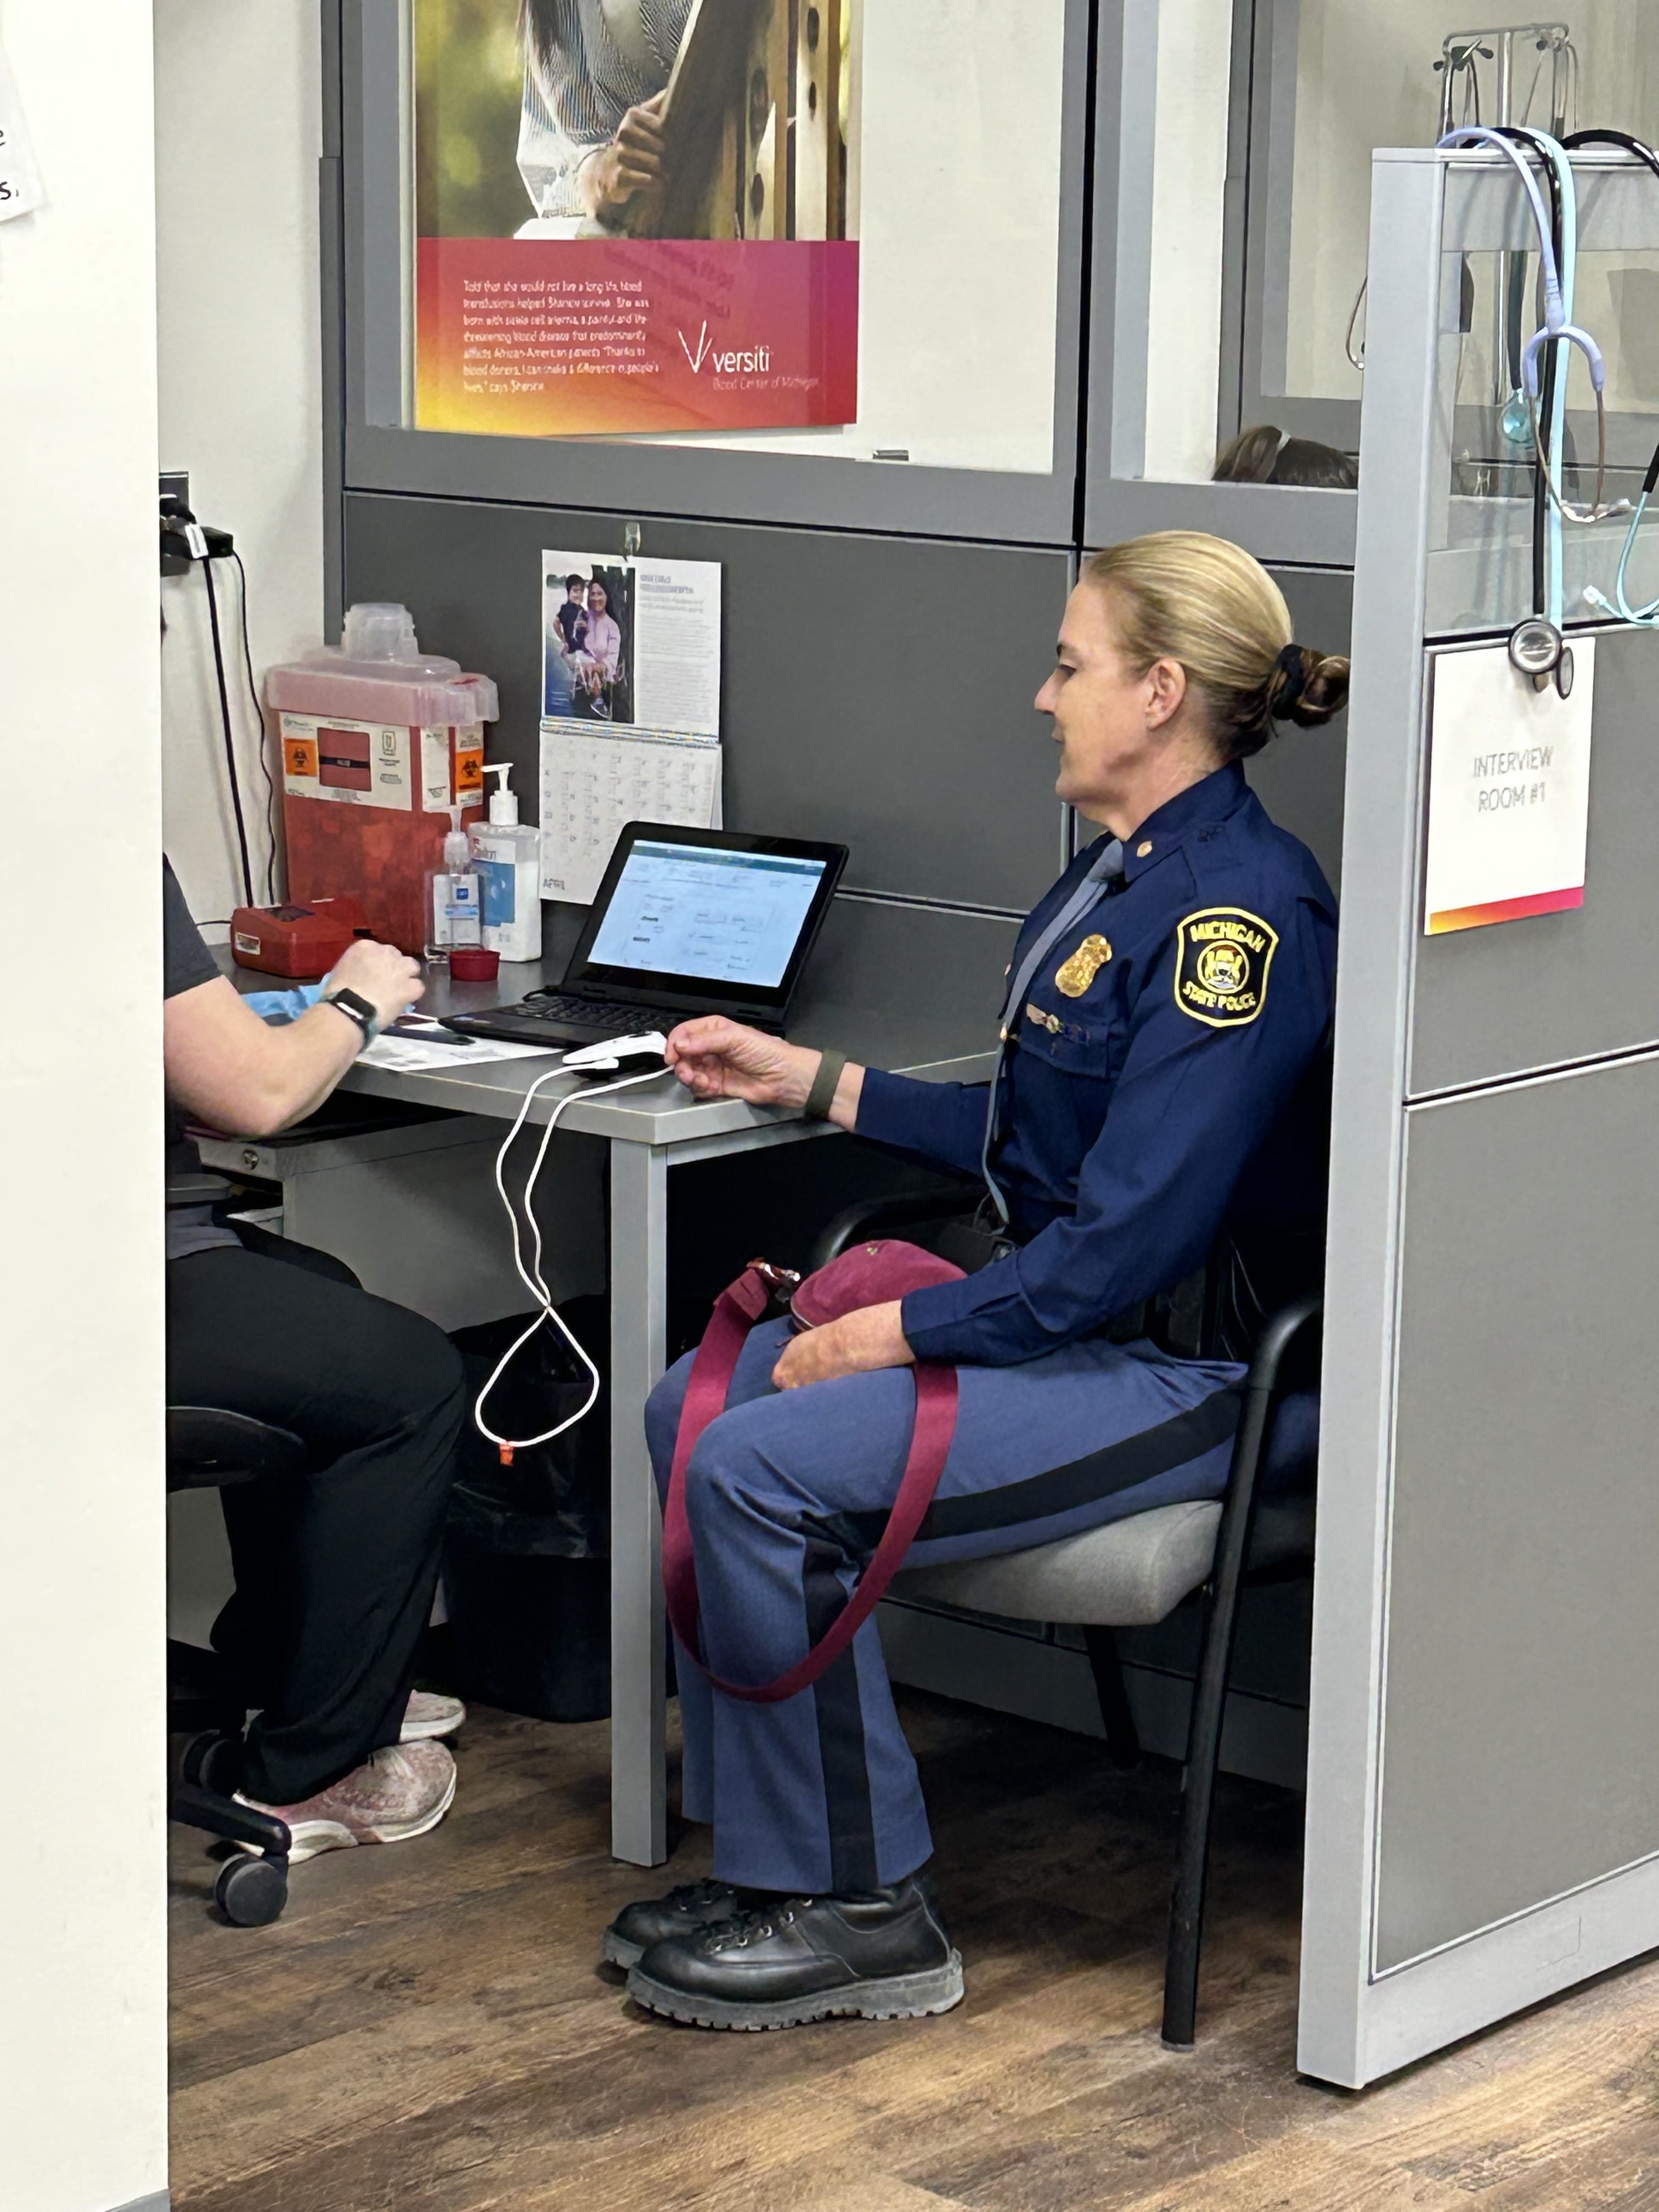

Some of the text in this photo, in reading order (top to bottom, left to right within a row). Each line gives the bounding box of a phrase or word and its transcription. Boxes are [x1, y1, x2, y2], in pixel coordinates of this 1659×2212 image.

[712, 345, 770, 373] versiti
[1473, 746, 1554, 778] INTERVIEW
[1478, 785, 1525, 812] ROOM
